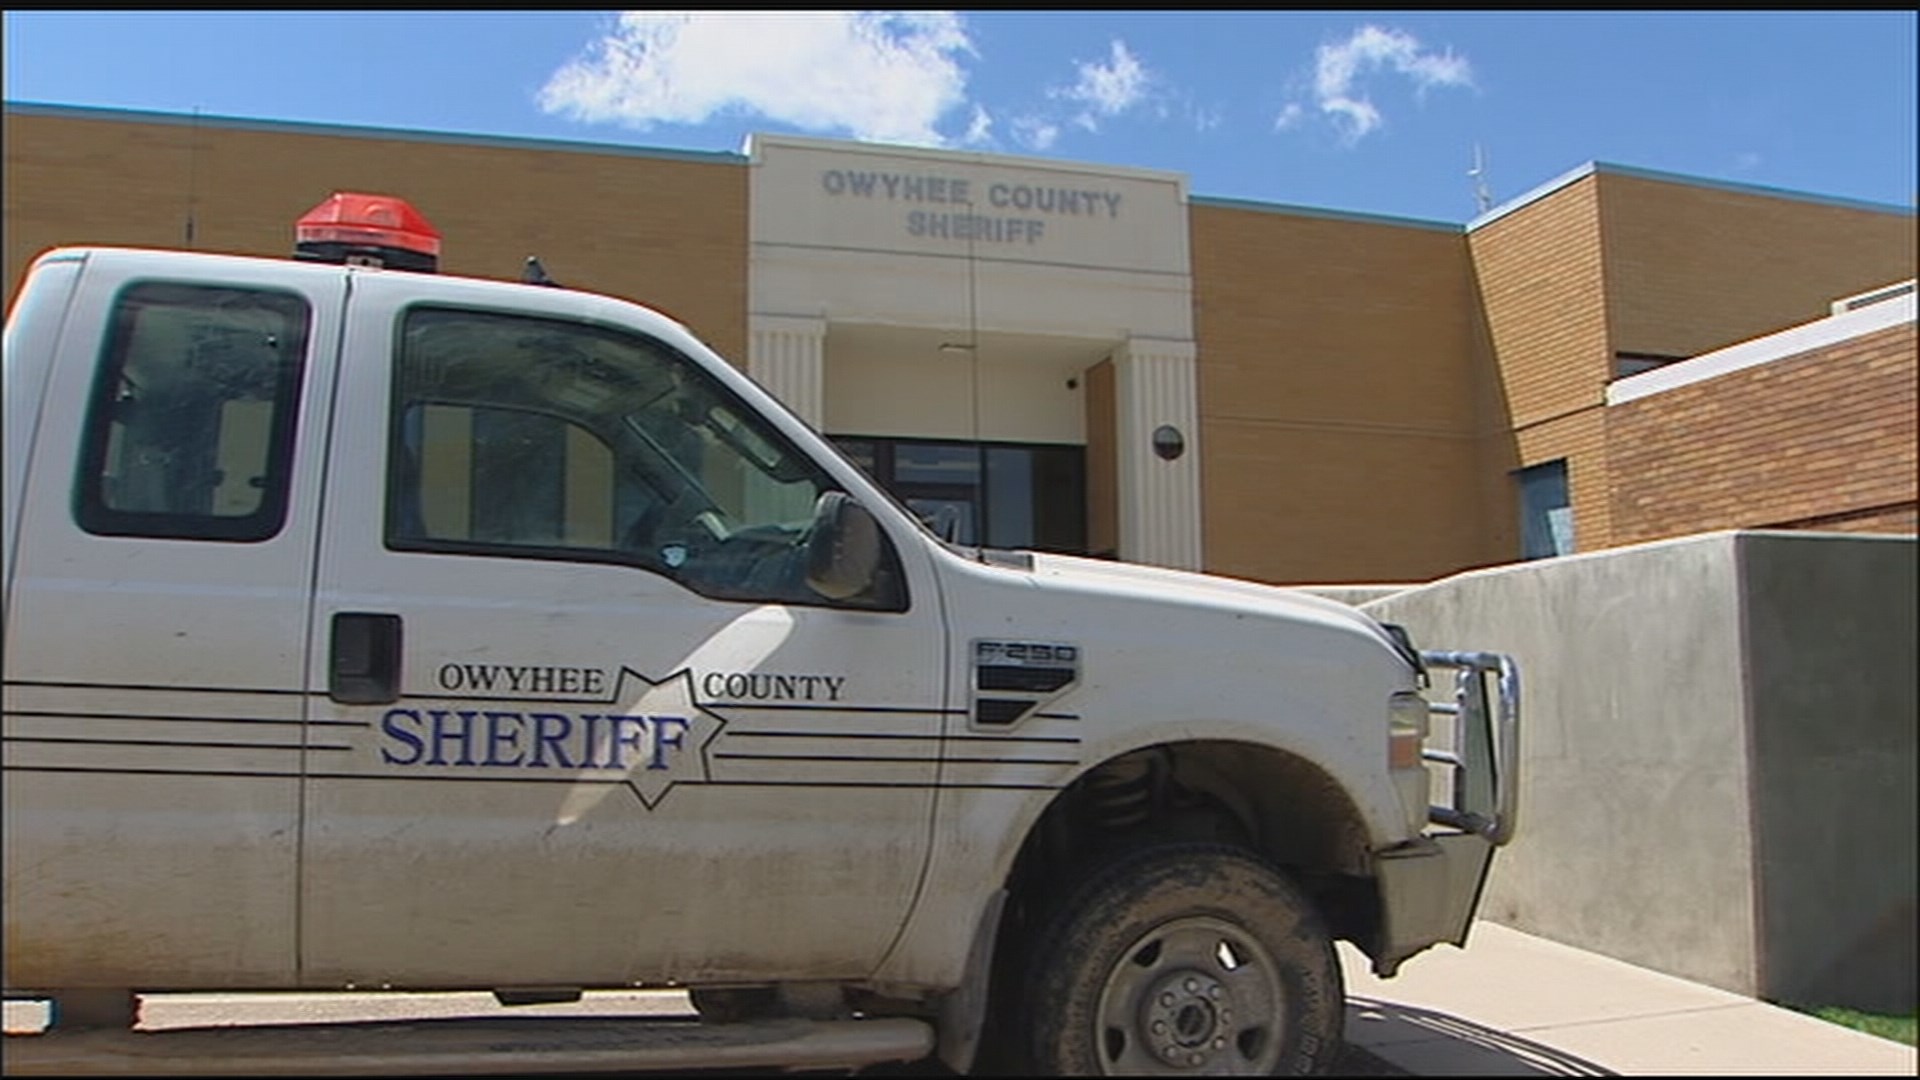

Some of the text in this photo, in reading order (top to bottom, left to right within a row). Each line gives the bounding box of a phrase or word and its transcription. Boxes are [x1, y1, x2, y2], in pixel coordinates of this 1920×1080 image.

[822, 169, 1122, 219] OWYHEE COUNTY
[906, 210, 1046, 245] SHERIFF
[977, 642, 1077, 661] F-250
[439, 664, 845, 701] OWYHEE COUNTY
[380, 709, 690, 771] SHERIFF
